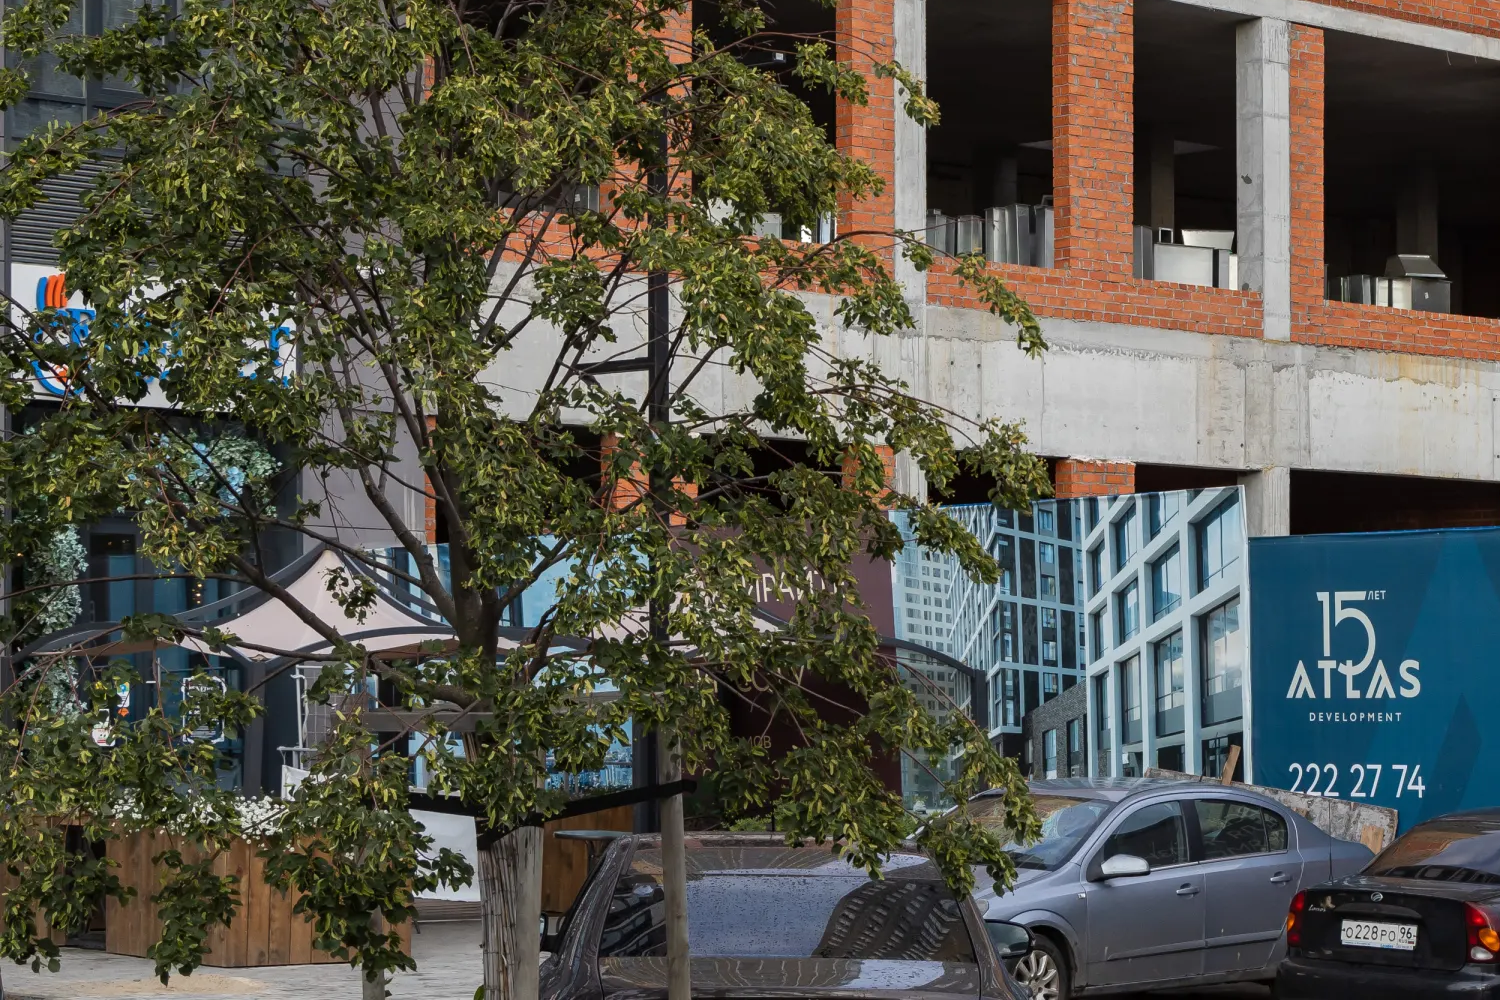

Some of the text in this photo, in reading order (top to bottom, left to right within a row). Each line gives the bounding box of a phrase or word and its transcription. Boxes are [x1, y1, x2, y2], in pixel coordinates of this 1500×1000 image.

[1316, 590, 1387, 676] 15 ЛЕТ
[1286, 659, 1421, 699] ATLAS
[1309, 712, 1402, 722] DEVELOPMENT
[1288, 762, 1426, 798] 222 27 74
[1400, 926, 1412, 939] 96
